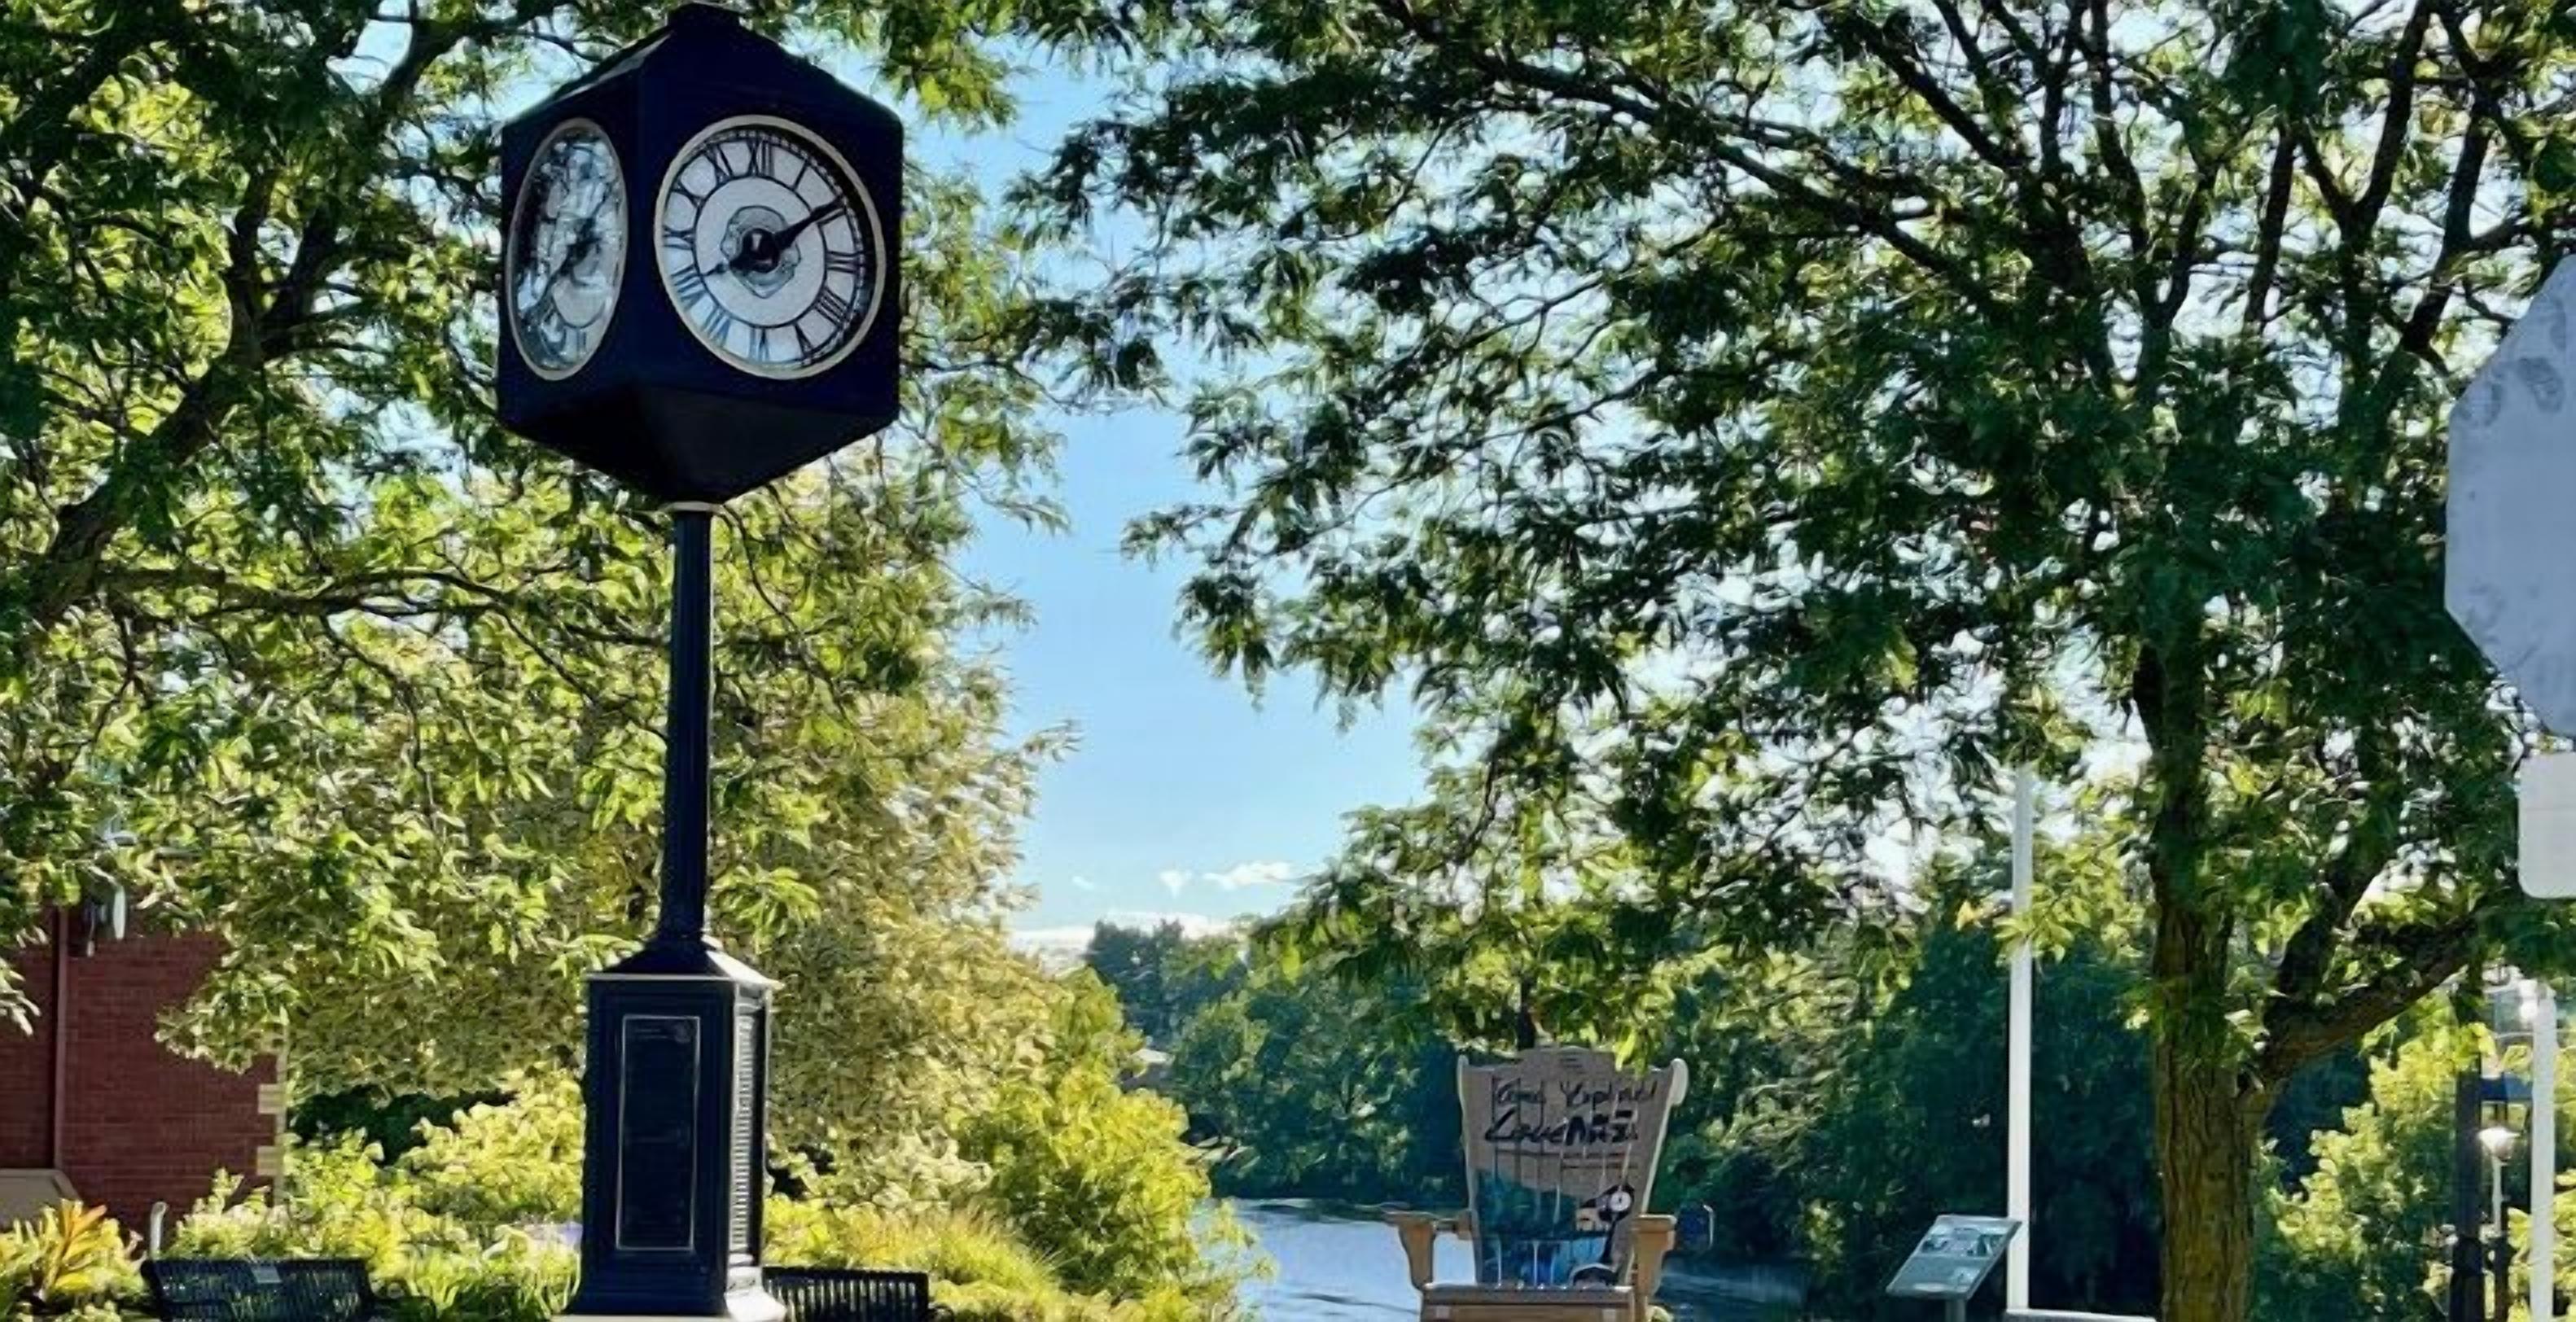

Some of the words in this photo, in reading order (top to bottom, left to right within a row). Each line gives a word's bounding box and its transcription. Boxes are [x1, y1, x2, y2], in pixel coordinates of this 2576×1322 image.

[705, 144, 734, 182] XI
[747, 138, 774, 177] XII
[793, 160, 809, 190] I
[671, 177, 705, 209] X
[826, 250, 859, 274] III
[671, 265, 706, 309] VIII
[815, 286, 849, 329] IIII
[793, 322, 814, 358] V
